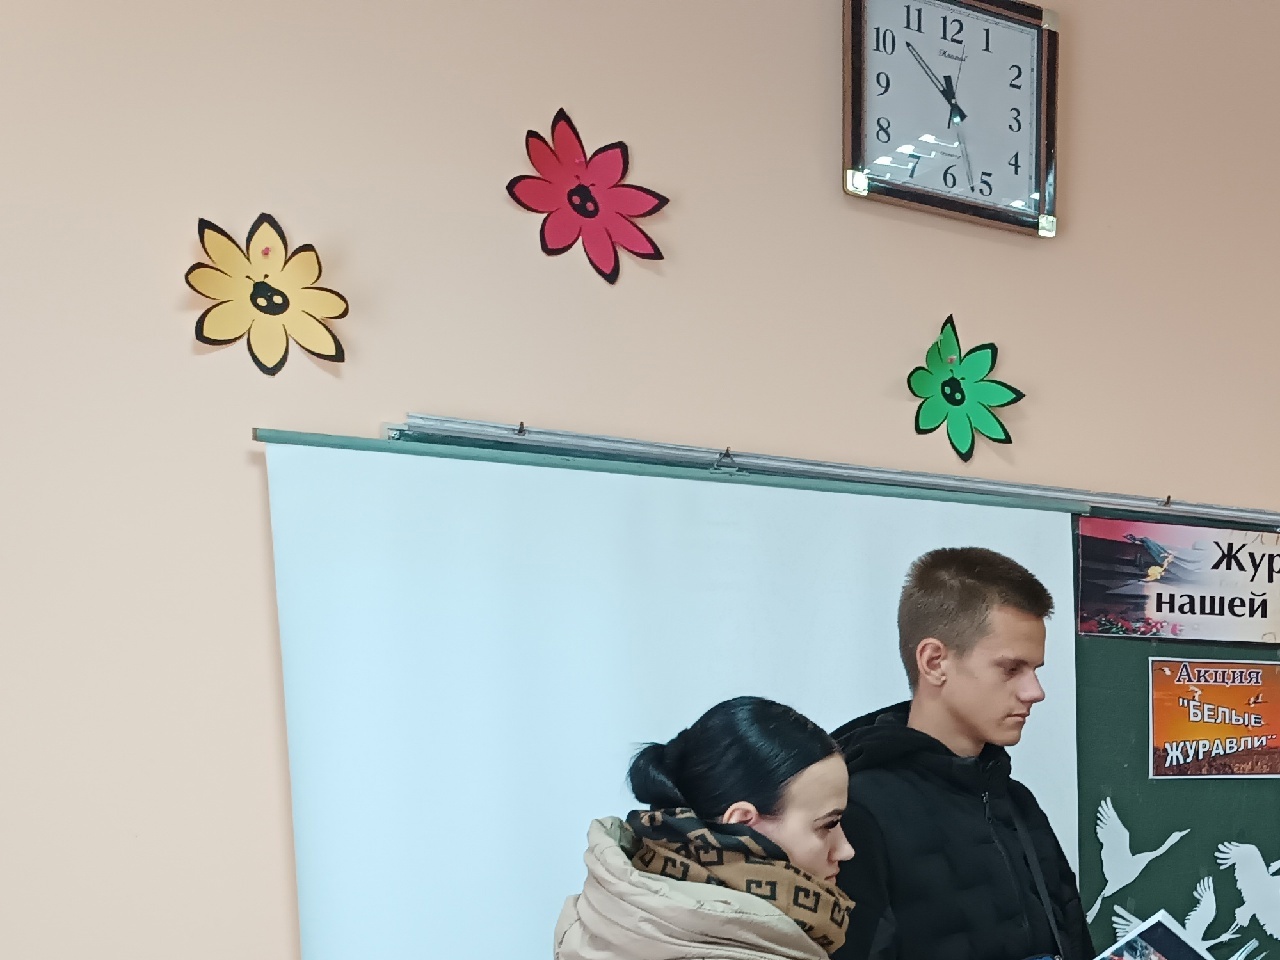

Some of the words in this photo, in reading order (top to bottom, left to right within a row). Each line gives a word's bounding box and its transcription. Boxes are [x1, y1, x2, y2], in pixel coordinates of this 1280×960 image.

[903, 4, 925, 34] 11
[940, 15, 965, 45] 12
[872, 26, 896, 56] 10
[982, 28, 993, 54] 1
[876, 71, 891, 97] 9
[1008, 64, 1023, 90] 2
[876, 116, 891, 144] 8
[1008, 107, 1022, 133] 3
[907, 152, 921, 179] 7
[942, 164, 957, 189] 6
[1008, 151, 1022, 176] 4
[978, 171, 993, 197] 5
[1156, 590, 1268, 619] нашей
[1174, 662, 1262, 687] Акция
[1178, 696, 1263, 727] "БЕЛЫЕ
